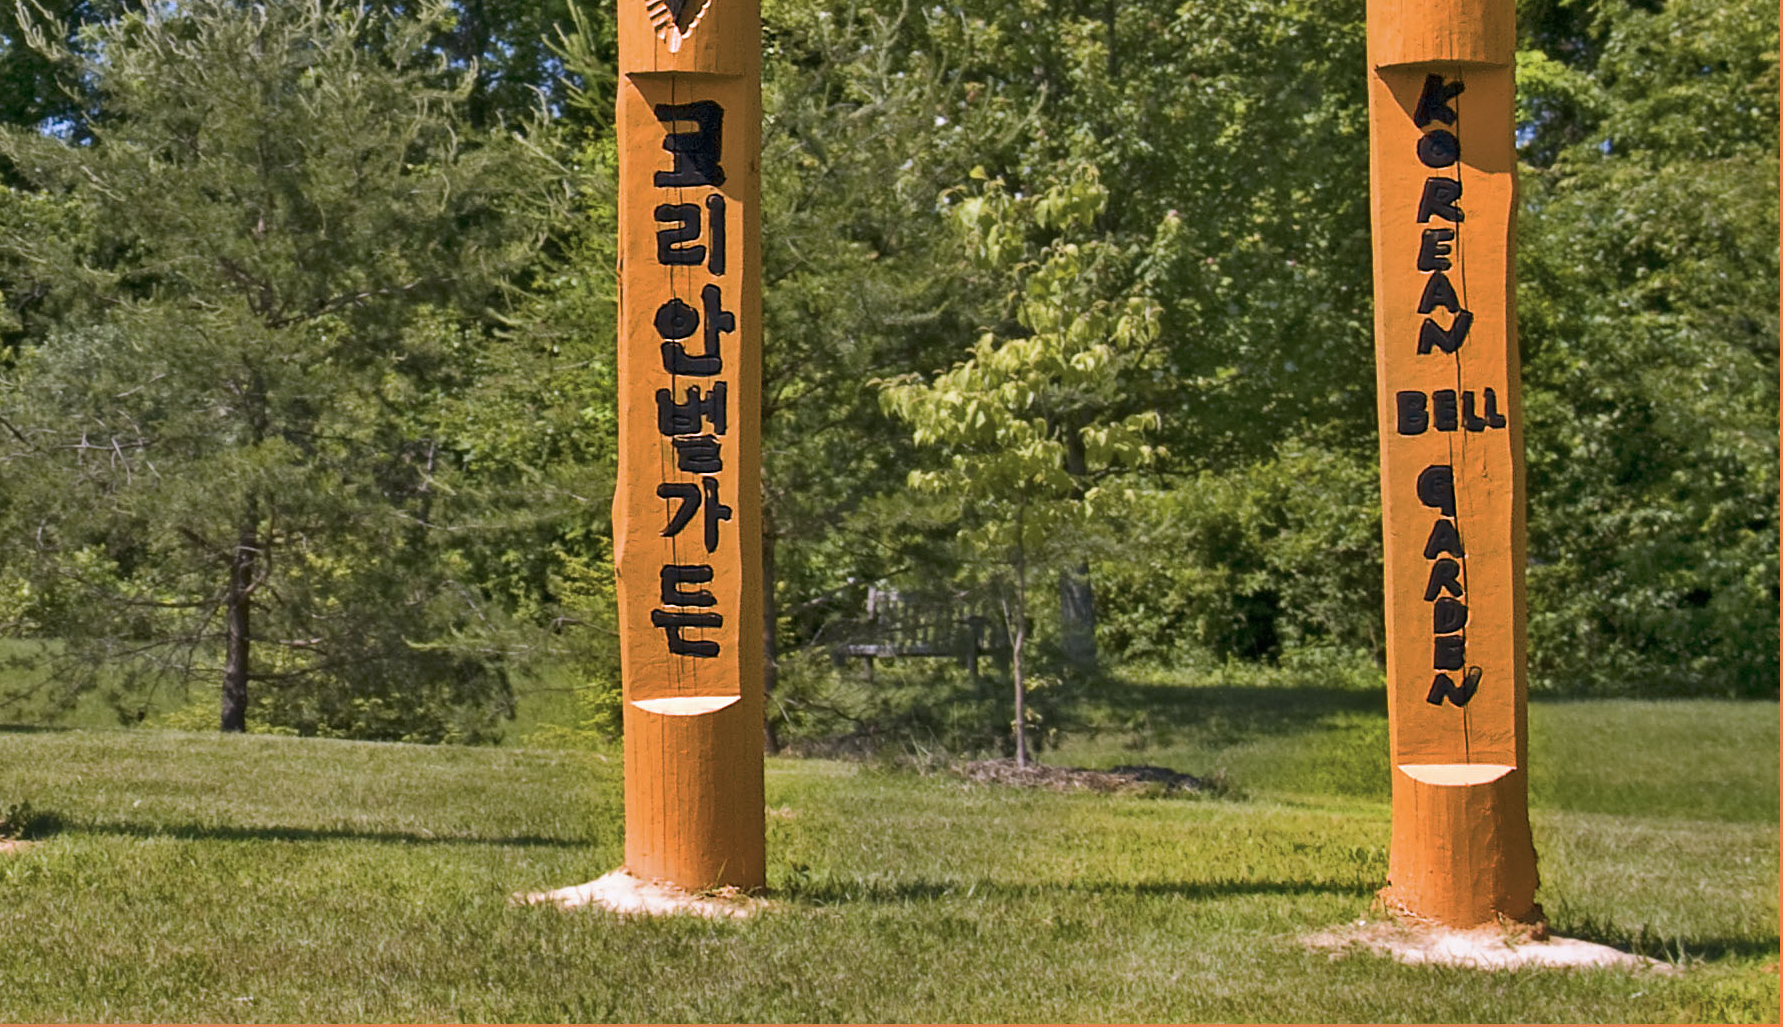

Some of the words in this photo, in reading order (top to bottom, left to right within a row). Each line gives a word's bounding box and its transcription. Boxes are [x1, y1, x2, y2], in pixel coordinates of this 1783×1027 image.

[1413, 73, 1473, 355] KOREAN
[1396, 387, 1507, 434] BELL
[1416, 464, 1483, 707] GARDEN
